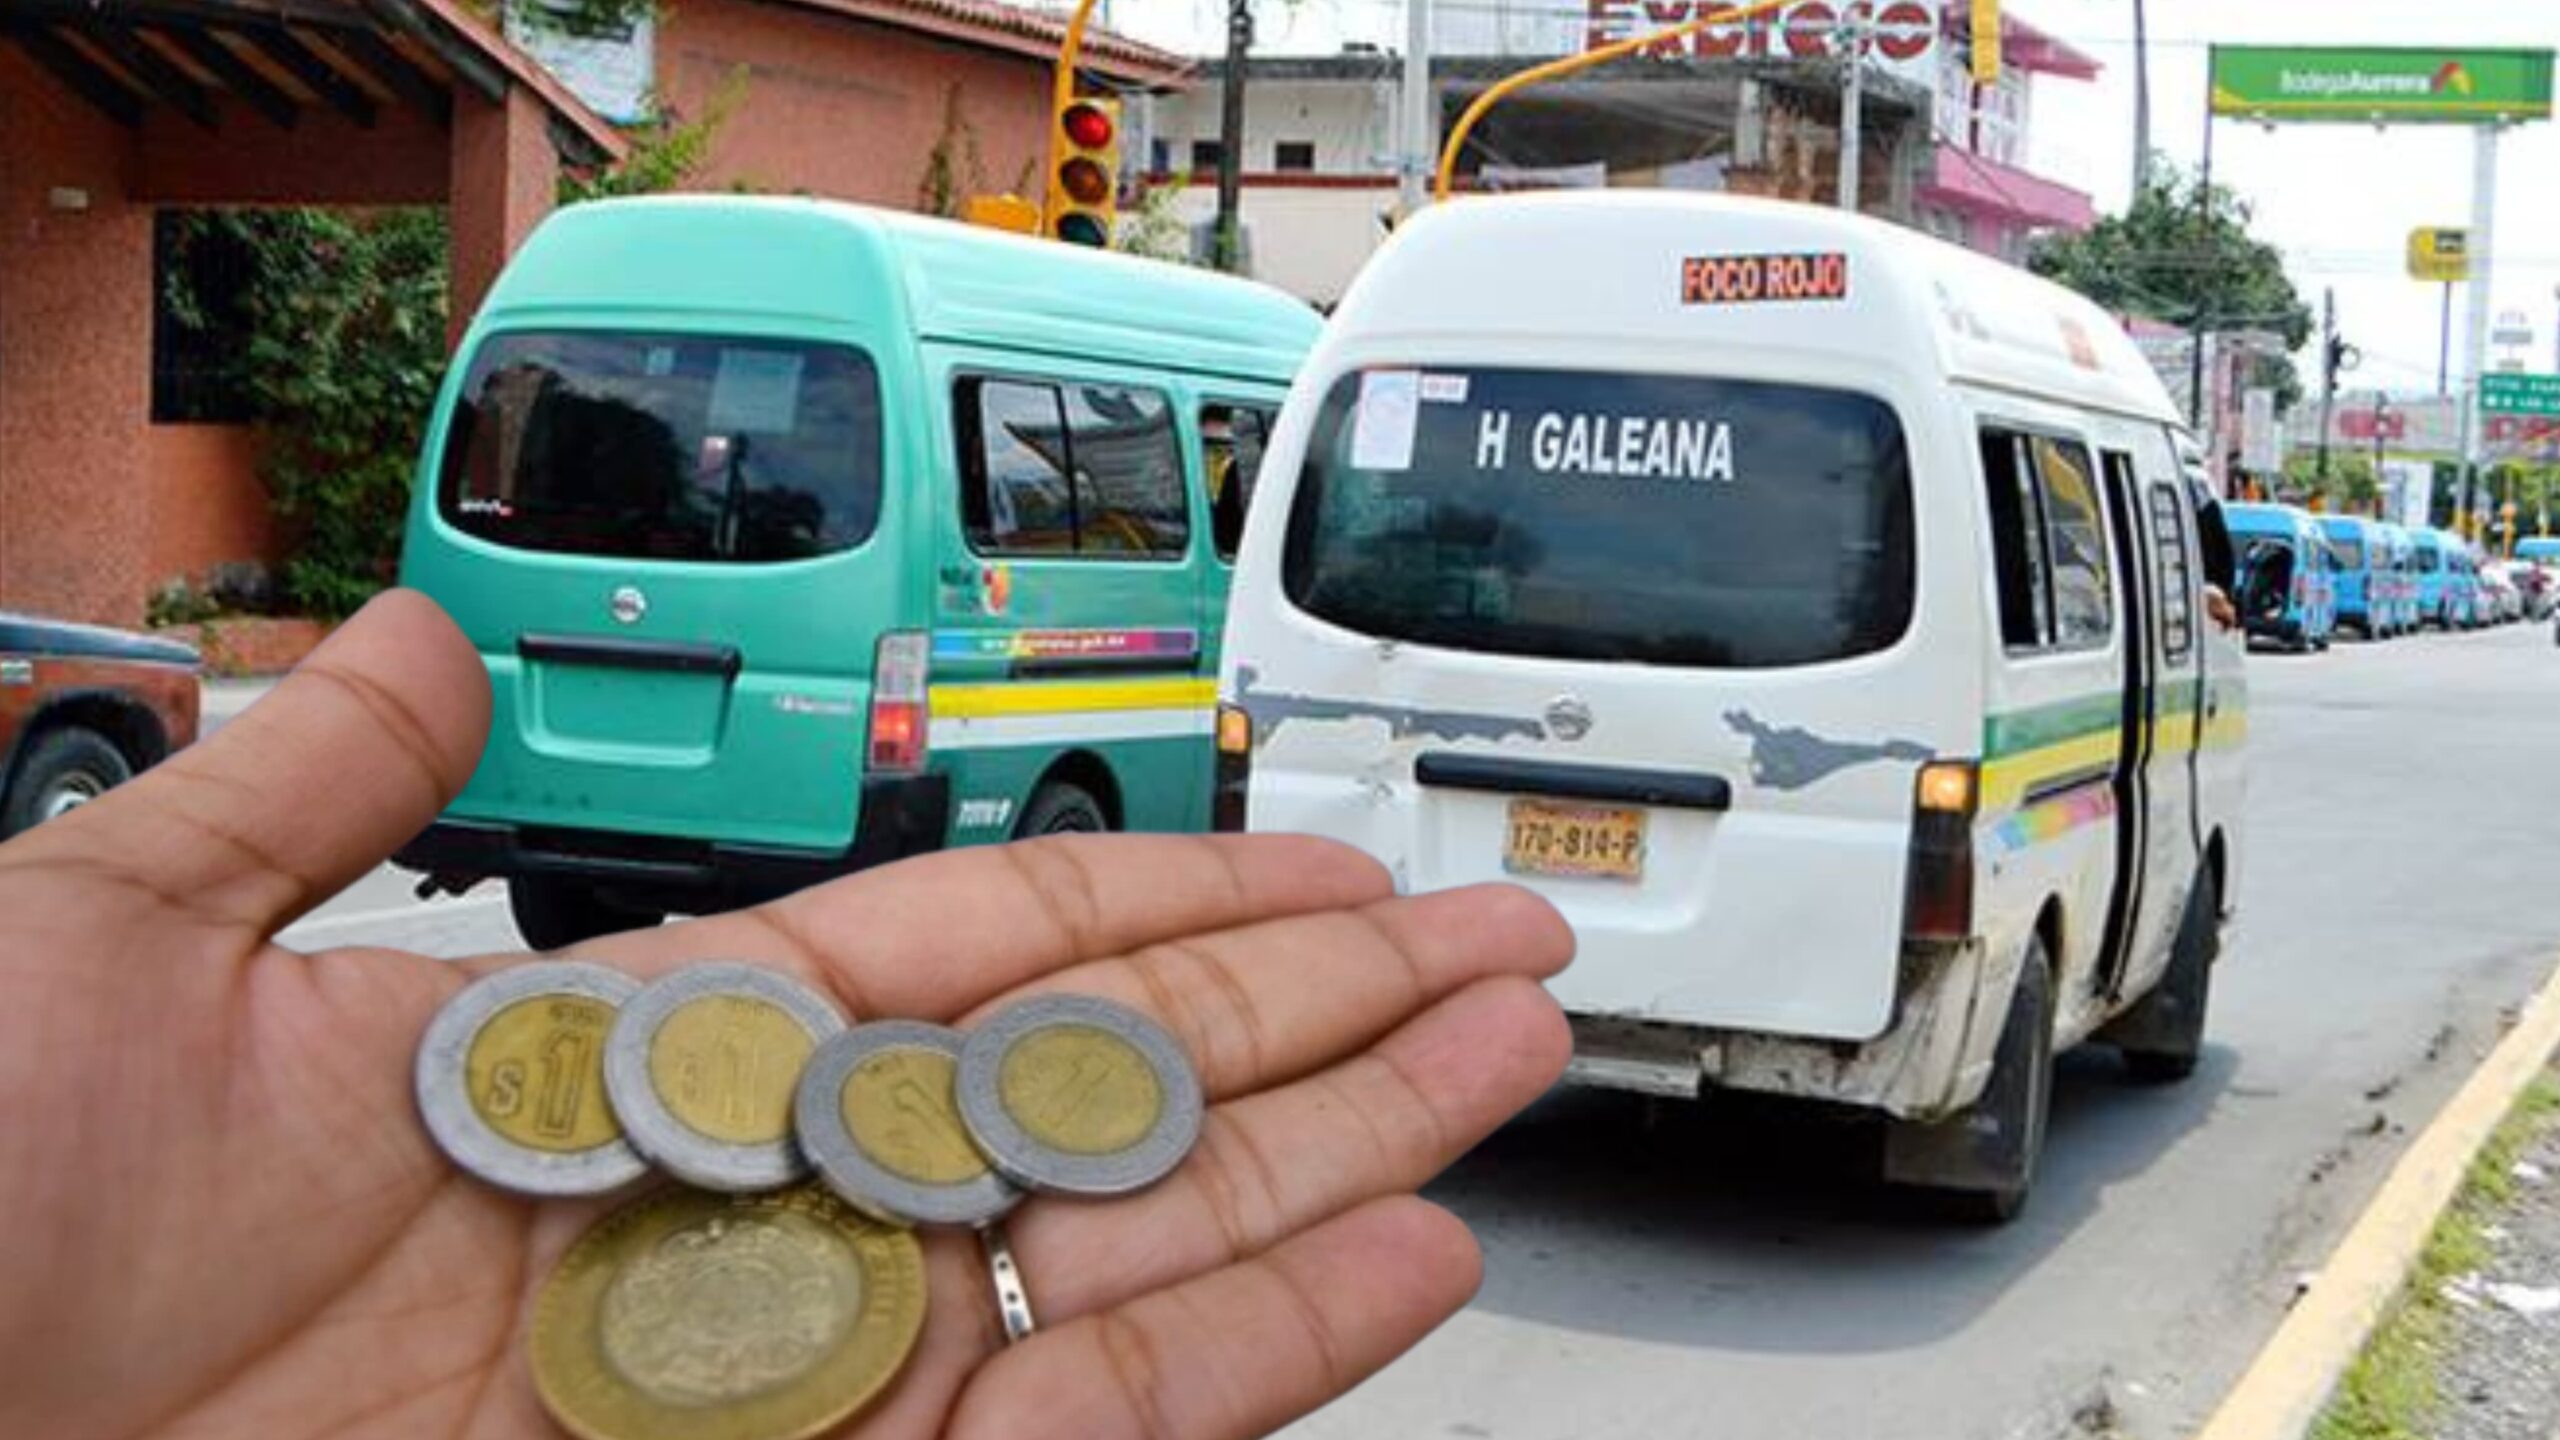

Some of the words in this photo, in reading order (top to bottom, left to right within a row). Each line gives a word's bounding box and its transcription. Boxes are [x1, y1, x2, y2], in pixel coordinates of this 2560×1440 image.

[1684, 259, 1759, 300] FOCO
[1766, 256, 1844, 297] ROJO
[1476, 410, 1511, 470] H
[1531, 412, 1736, 481] GALEANA
